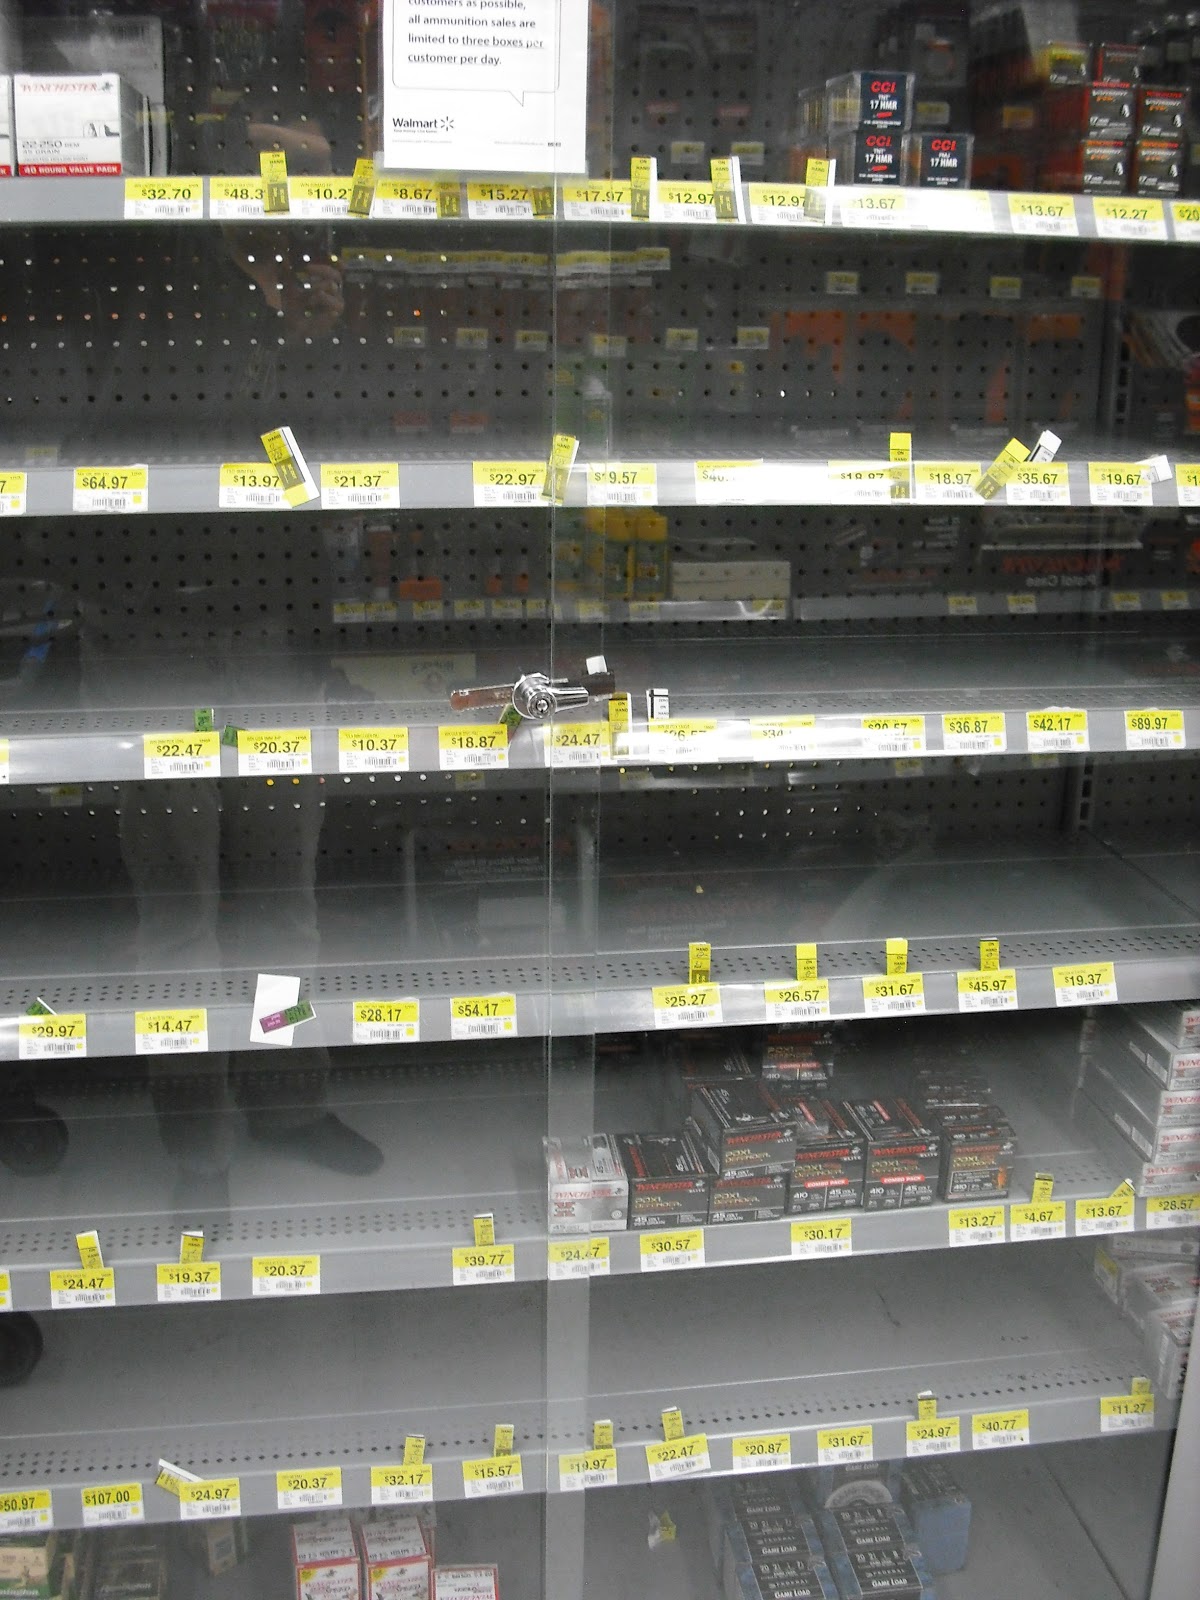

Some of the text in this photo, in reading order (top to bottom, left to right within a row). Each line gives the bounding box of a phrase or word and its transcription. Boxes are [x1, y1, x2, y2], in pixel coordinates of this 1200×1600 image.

[471, 0, 478, 8] as
[480, 0, 526, 10] possible,
[408, 15, 536, 28] all ammunition sales are
[408, 33, 445, 44] limited
[448, 35, 459, 45] to
[462, 34, 490, 46] three
[492, 36, 523, 47] boxes
[408, 53, 502, 66] customer per day.
[20, 82, 98, 93] WINCHESTER
[871, 81, 896, 93] CCI
[870, 101, 897, 110] 17 HMR
[393, 118, 437, 128] Walmart
[866, 135, 892, 147] CCI
[931, 139, 956, 151] CCI
[865, 154, 893, 163] 17 HMR
[930, 158, 958, 168] 17 HMR
[24, 166, 37, 174] 40
[39, 166, 68, 174] ROUND
[70, 166, 95, 174] VALUE
[142, 188, 191, 200] $32.70
[224, 188, 265, 200] $48.3
[308, 188, 351, 200] $10.2
[394, 188, 433, 200] $8.67
[481, 188, 528, 201] $15.27
[577, 190, 624, 203] $17.97
[669, 192, 714, 205] $12.97
[1021, 205, 1064, 217] $13.67
[1106, 207, 1147, 220] $12.27
[82, 476, 128, 490] $64.97
[234, 475, 280, 487] $13.97
[334, 475, 382, 488] $21.37
[490, 474, 536, 485] $22.97
[929, 473, 971, 485] $18.97
[1017, 473, 1058, 485] $35.67
[1101, 473, 1141, 485] $19.67
[949, 721, 988, 734] $36.87
[1033, 718, 1071, 731] $42.17
[1131, 717, 1168, 730] $89.97
[352, 739, 397, 751] $10.37
[452, 736, 496, 748] $18.87
[556, 734, 600, 746] $24.47
[157, 744, 203, 757] $22.47
[254, 741, 300, 754] $20.37
[1065, 973, 1102, 986] $19.37
[875, 983, 915, 996] $31.67
[968, 980, 1007, 992] $45.97
[665, 994, 707, 1007] $25.27
[779, 990, 820, 1002] $26.57
[360, 1009, 402, 1022] $28.17
[458, 1004, 498, 1017] $54.17
[32, 1026, 75, 1038] $29.97
[148, 1021, 192, 1033] $14.47
[1086, 1206, 1122, 1217] $13.67
[1158, 1200, 1194, 1211] $28.57
[959, 1215, 996, 1228] $13.27
[1024, 1211, 1053, 1223] $4.67
[805, 1228, 842, 1240] $30.17
[652, 1240, 691, 1252] $30.57
[465, 1255, 505, 1266] $39.77
[265, 1265, 305, 1277] $20.37
[63, 1278, 104, 1290] $24.47
[170, 1272, 211, 1284] $19.37
[1112, 1403, 1146, 1414] $11.27
[982, 1419, 1016, 1431] $40.77
[916, 1427, 951, 1439] $24.97
[828, 1436, 864, 1447] $31.67
[657, 1446, 695, 1461] $22.47
[745, 1443, 782, 1456] $20.87
[475, 1465, 513, 1478] $15.57
[288, 1477, 328, 1490] $20.37
[384, 1474, 424, 1486] $32.17
[85, 1490, 130, 1505] $107.00
[191, 1488, 230, 1501] $24.97
